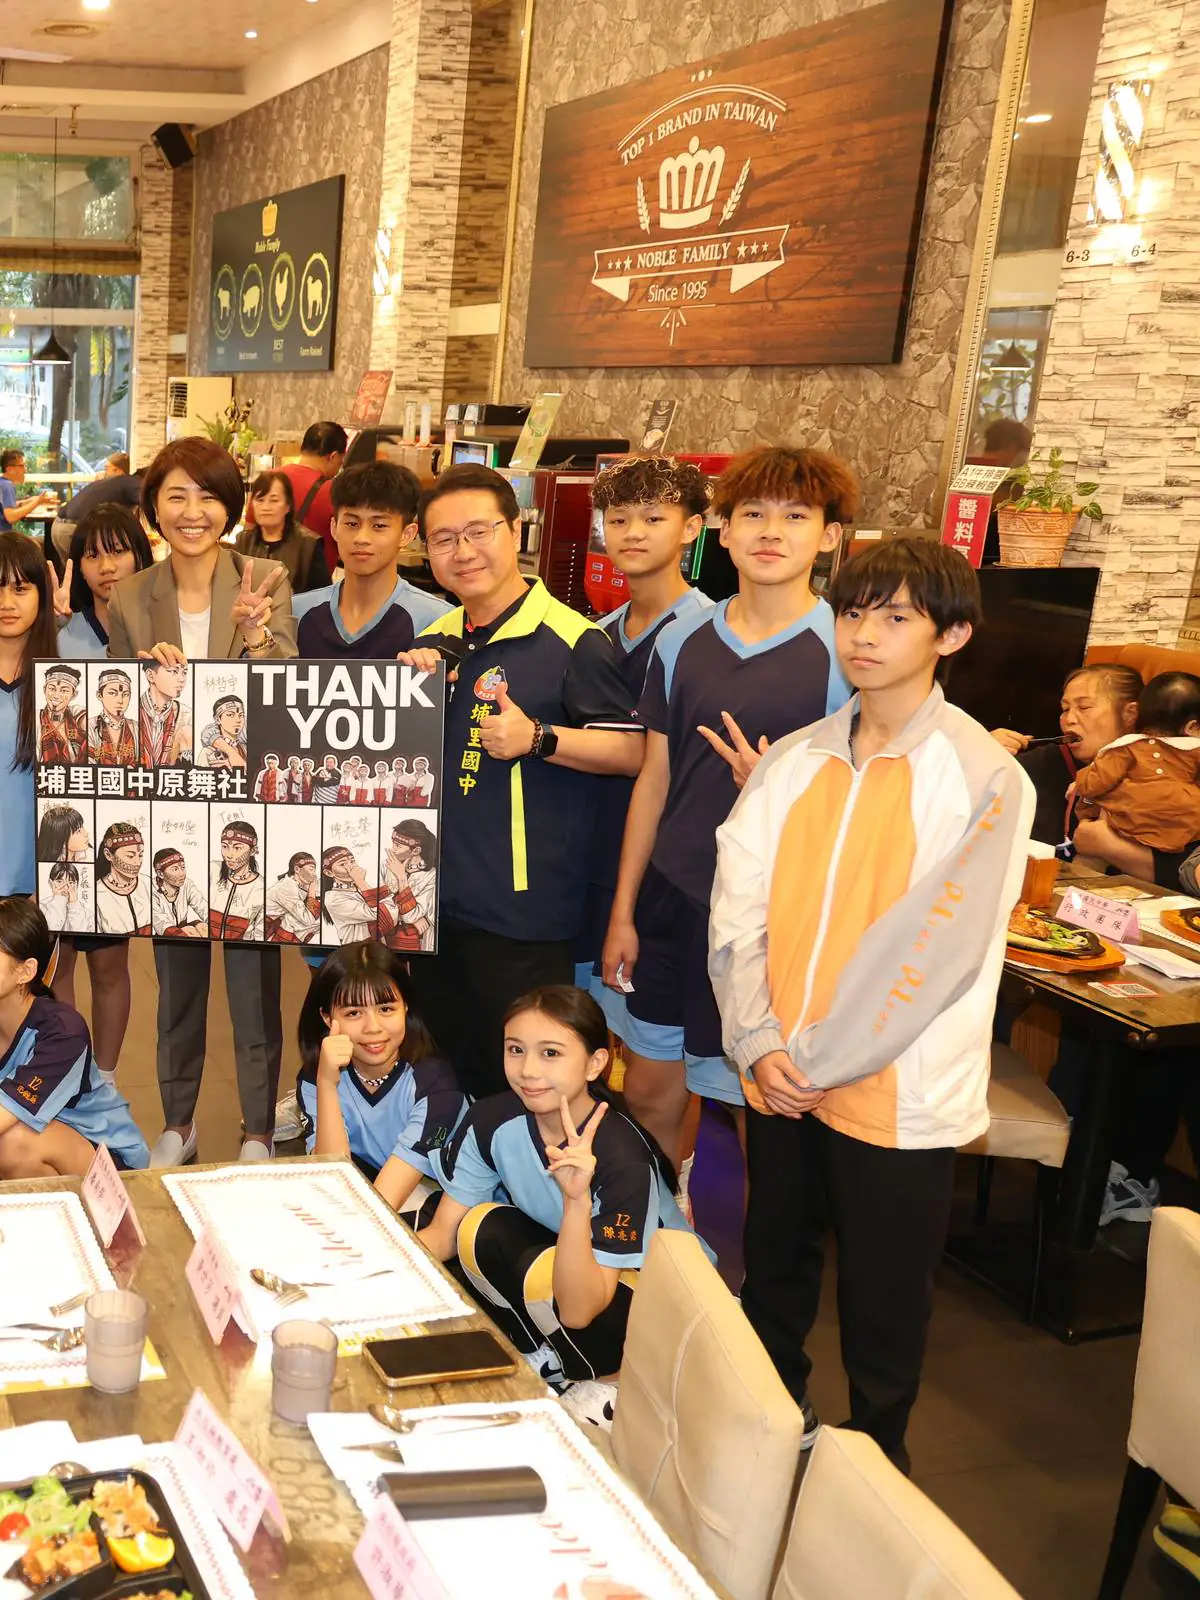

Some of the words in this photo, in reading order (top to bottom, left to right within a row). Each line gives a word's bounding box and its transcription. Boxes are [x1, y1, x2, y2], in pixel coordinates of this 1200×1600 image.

[621, 138, 646, 166] TOP
[648, 133, 654, 146] 1
[657, 107, 702, 141] BRAND
[704, 103, 721, 122] IN
[723, 101, 778, 133] TAIWAN
[636, 249, 677, 269] NOBLE
[681, 242, 731, 264] FAMILY
[1066, 249, 1090, 263] 6-3
[1131, 243, 1157, 258] 6-4
[648, 283, 679, 303] Since
[681, 280, 708, 300] 1995
[251, 664, 436, 708] THANK
[287, 708, 397, 751] YOU
[458, 703, 493, 796] 埔里國中
[37, 765, 248, 799] 埔里國中原舞社
[28, 1076, 43, 1091] 12
[615, 1213, 632, 1227] 12
